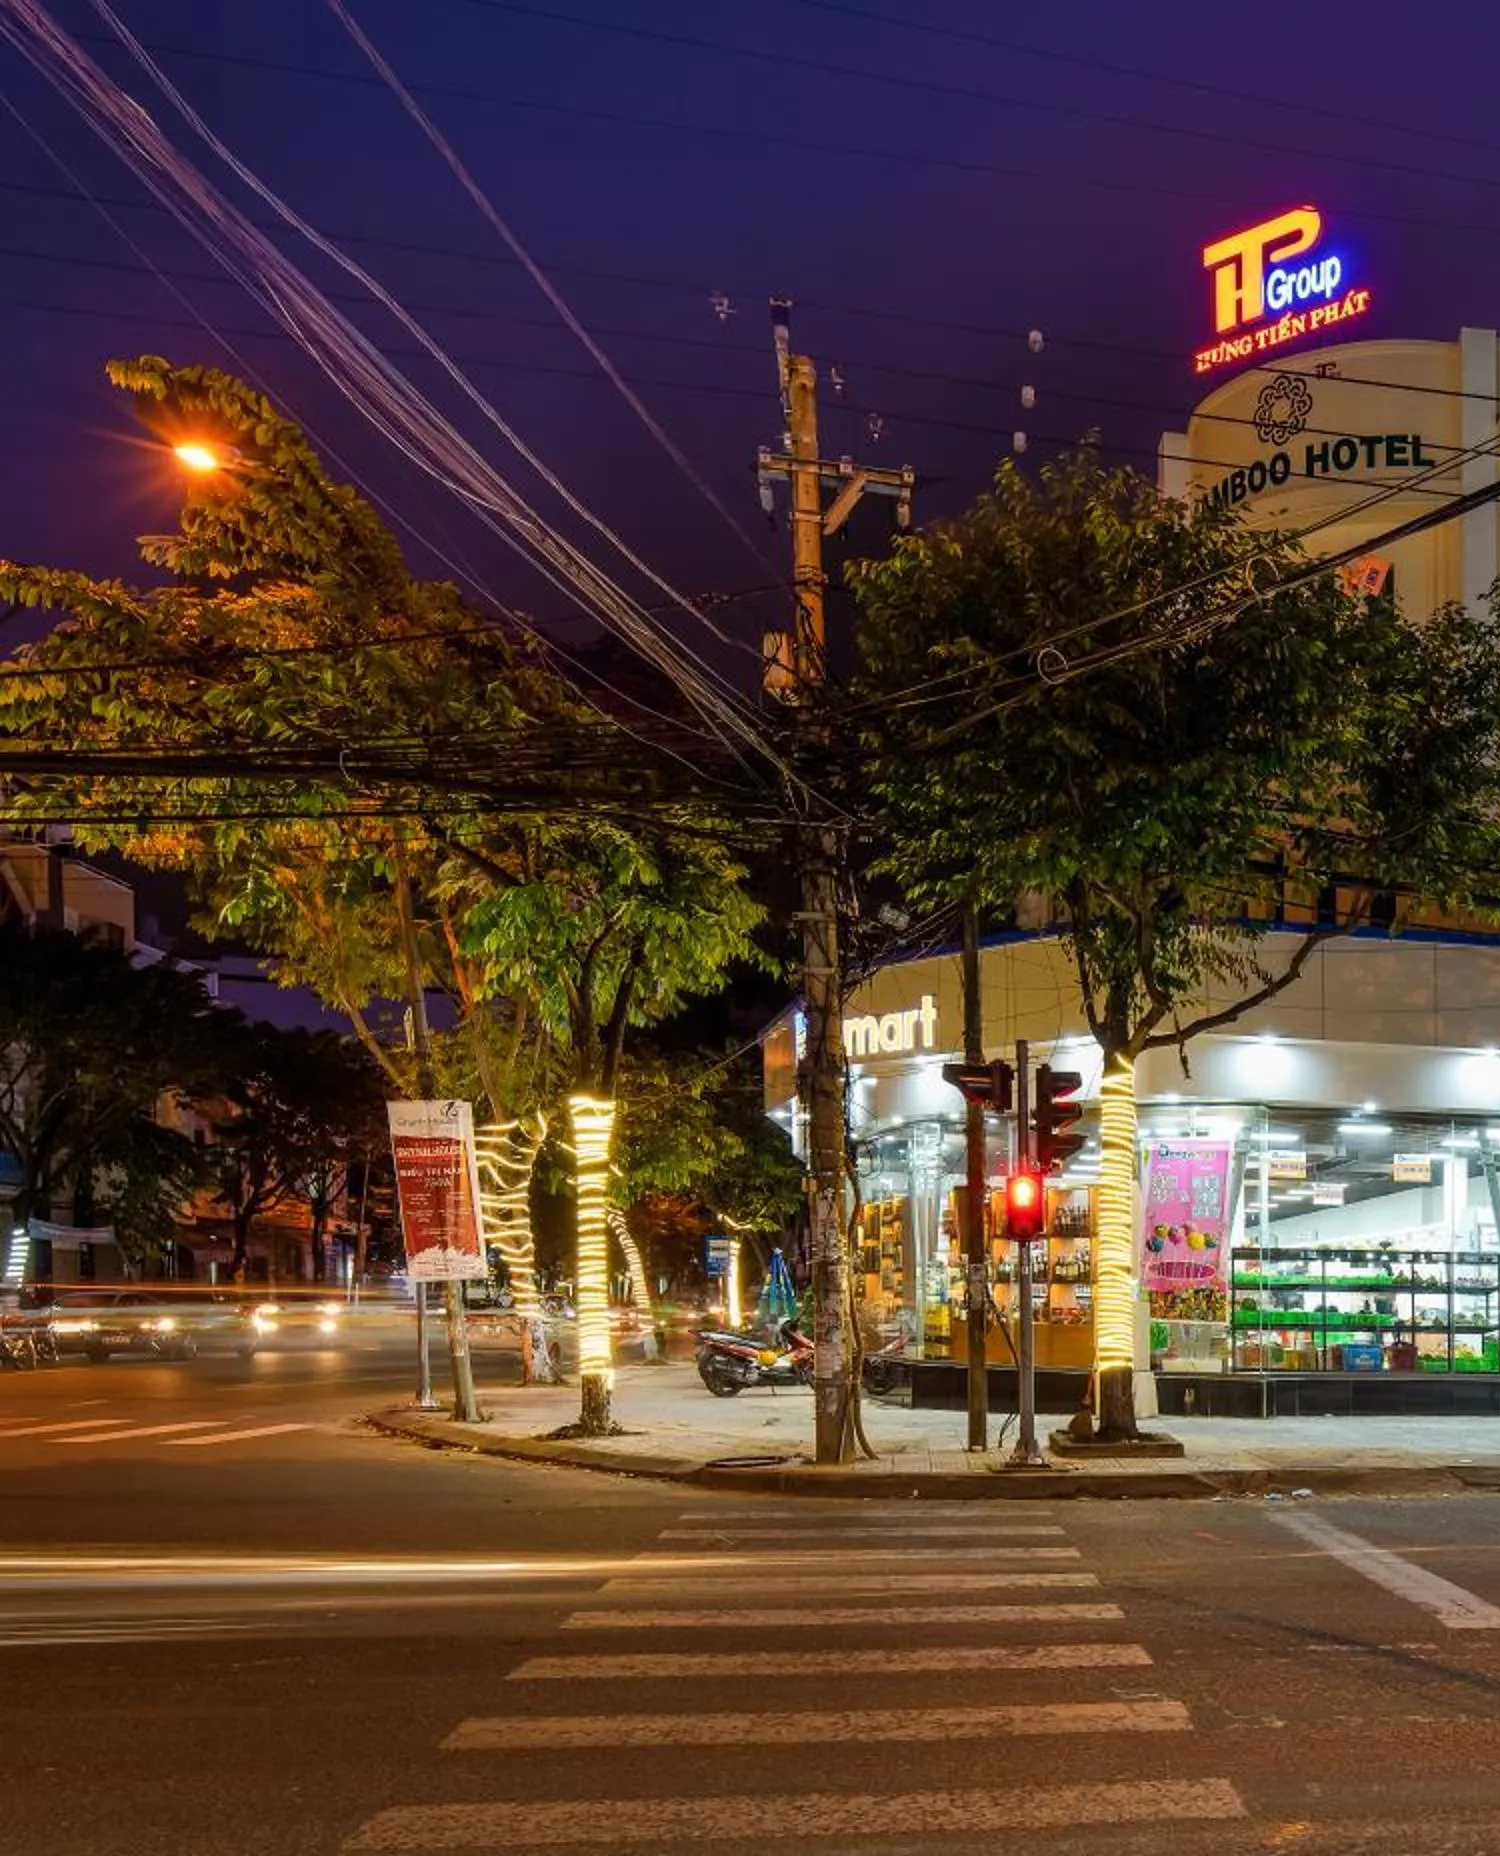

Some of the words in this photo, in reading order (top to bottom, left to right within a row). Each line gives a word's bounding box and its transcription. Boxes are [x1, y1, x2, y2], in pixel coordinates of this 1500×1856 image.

[1267, 256, 1341, 310] Group
[1255, 311, 1306, 349] TIẾN
[1309, 289, 1369, 330] PHÁT
[1304, 434, 1436, 478] HOTEL
[842, 994, 937, 1056] mart
